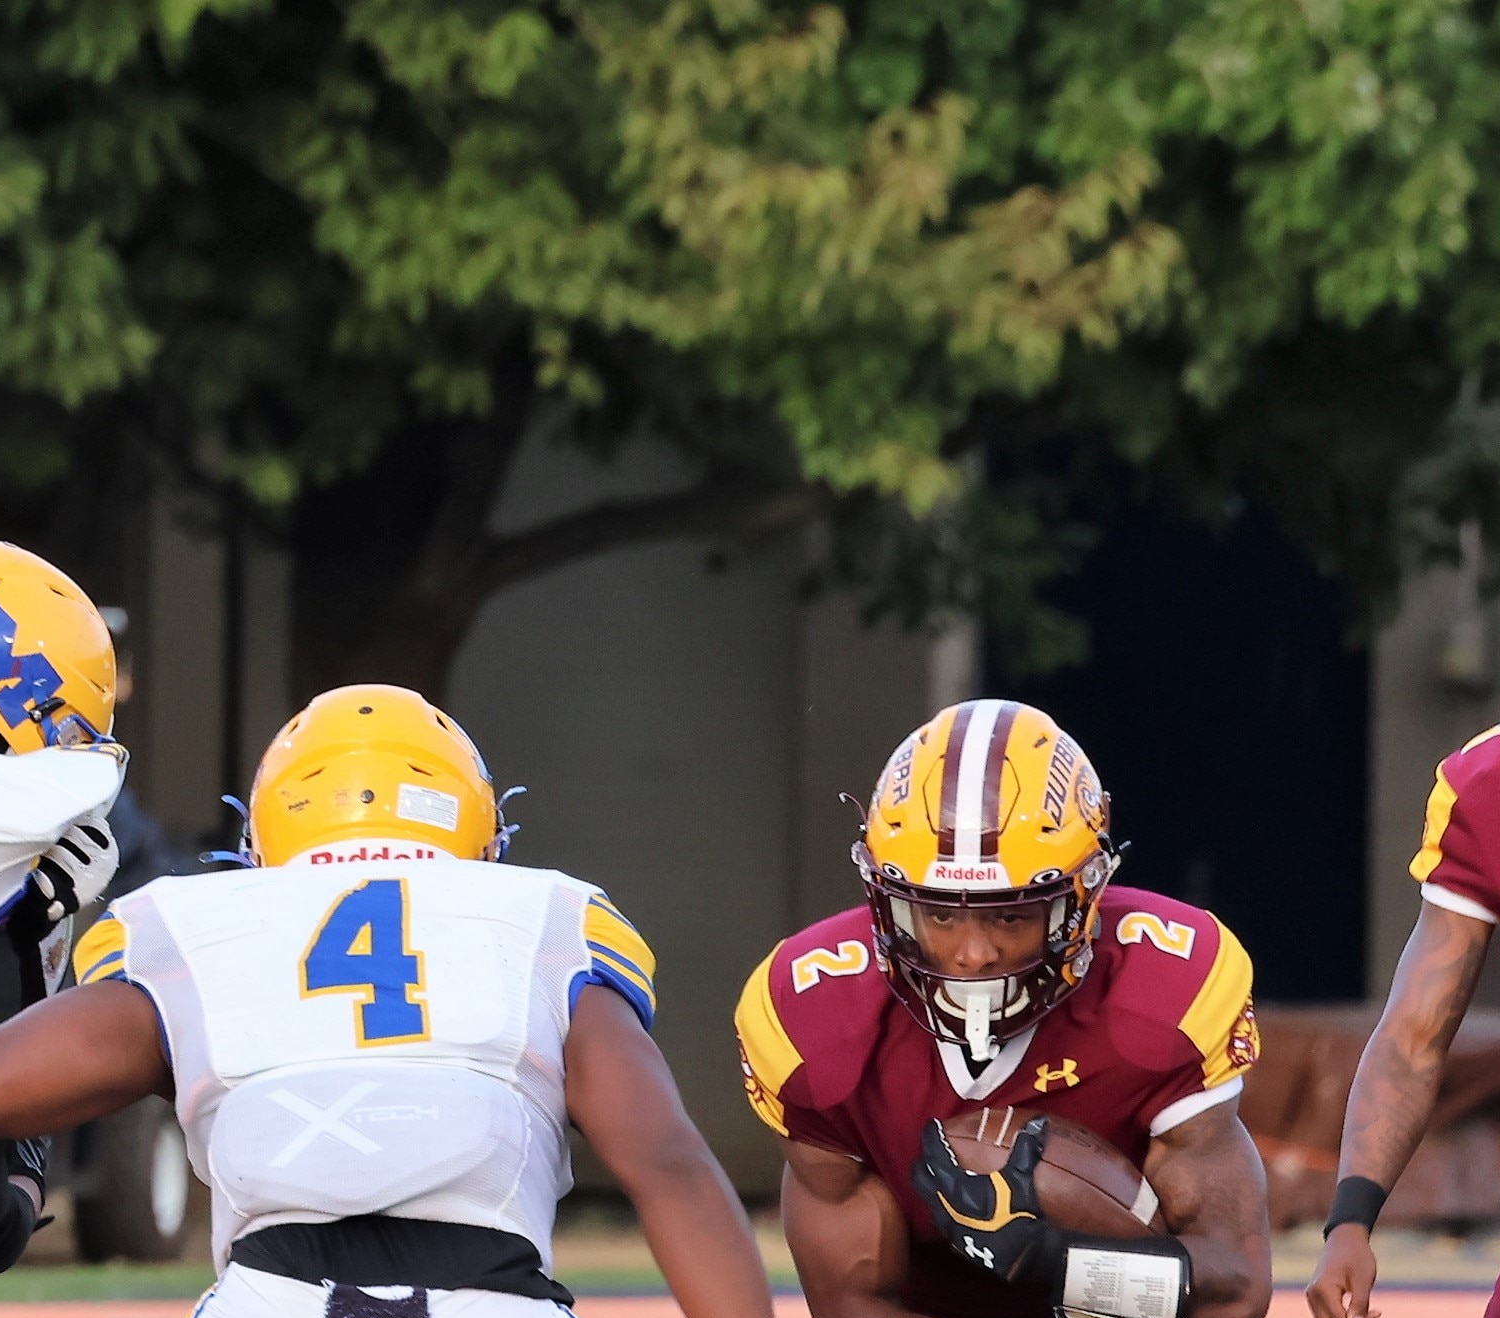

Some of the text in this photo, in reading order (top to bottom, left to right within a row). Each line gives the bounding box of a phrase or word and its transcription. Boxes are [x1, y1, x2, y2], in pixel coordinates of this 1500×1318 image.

[935, 865, 998, 881] Riddell
[1116, 911, 1197, 961] 2
[298, 877, 432, 1049] 4
[790, 939, 870, 995] 2
